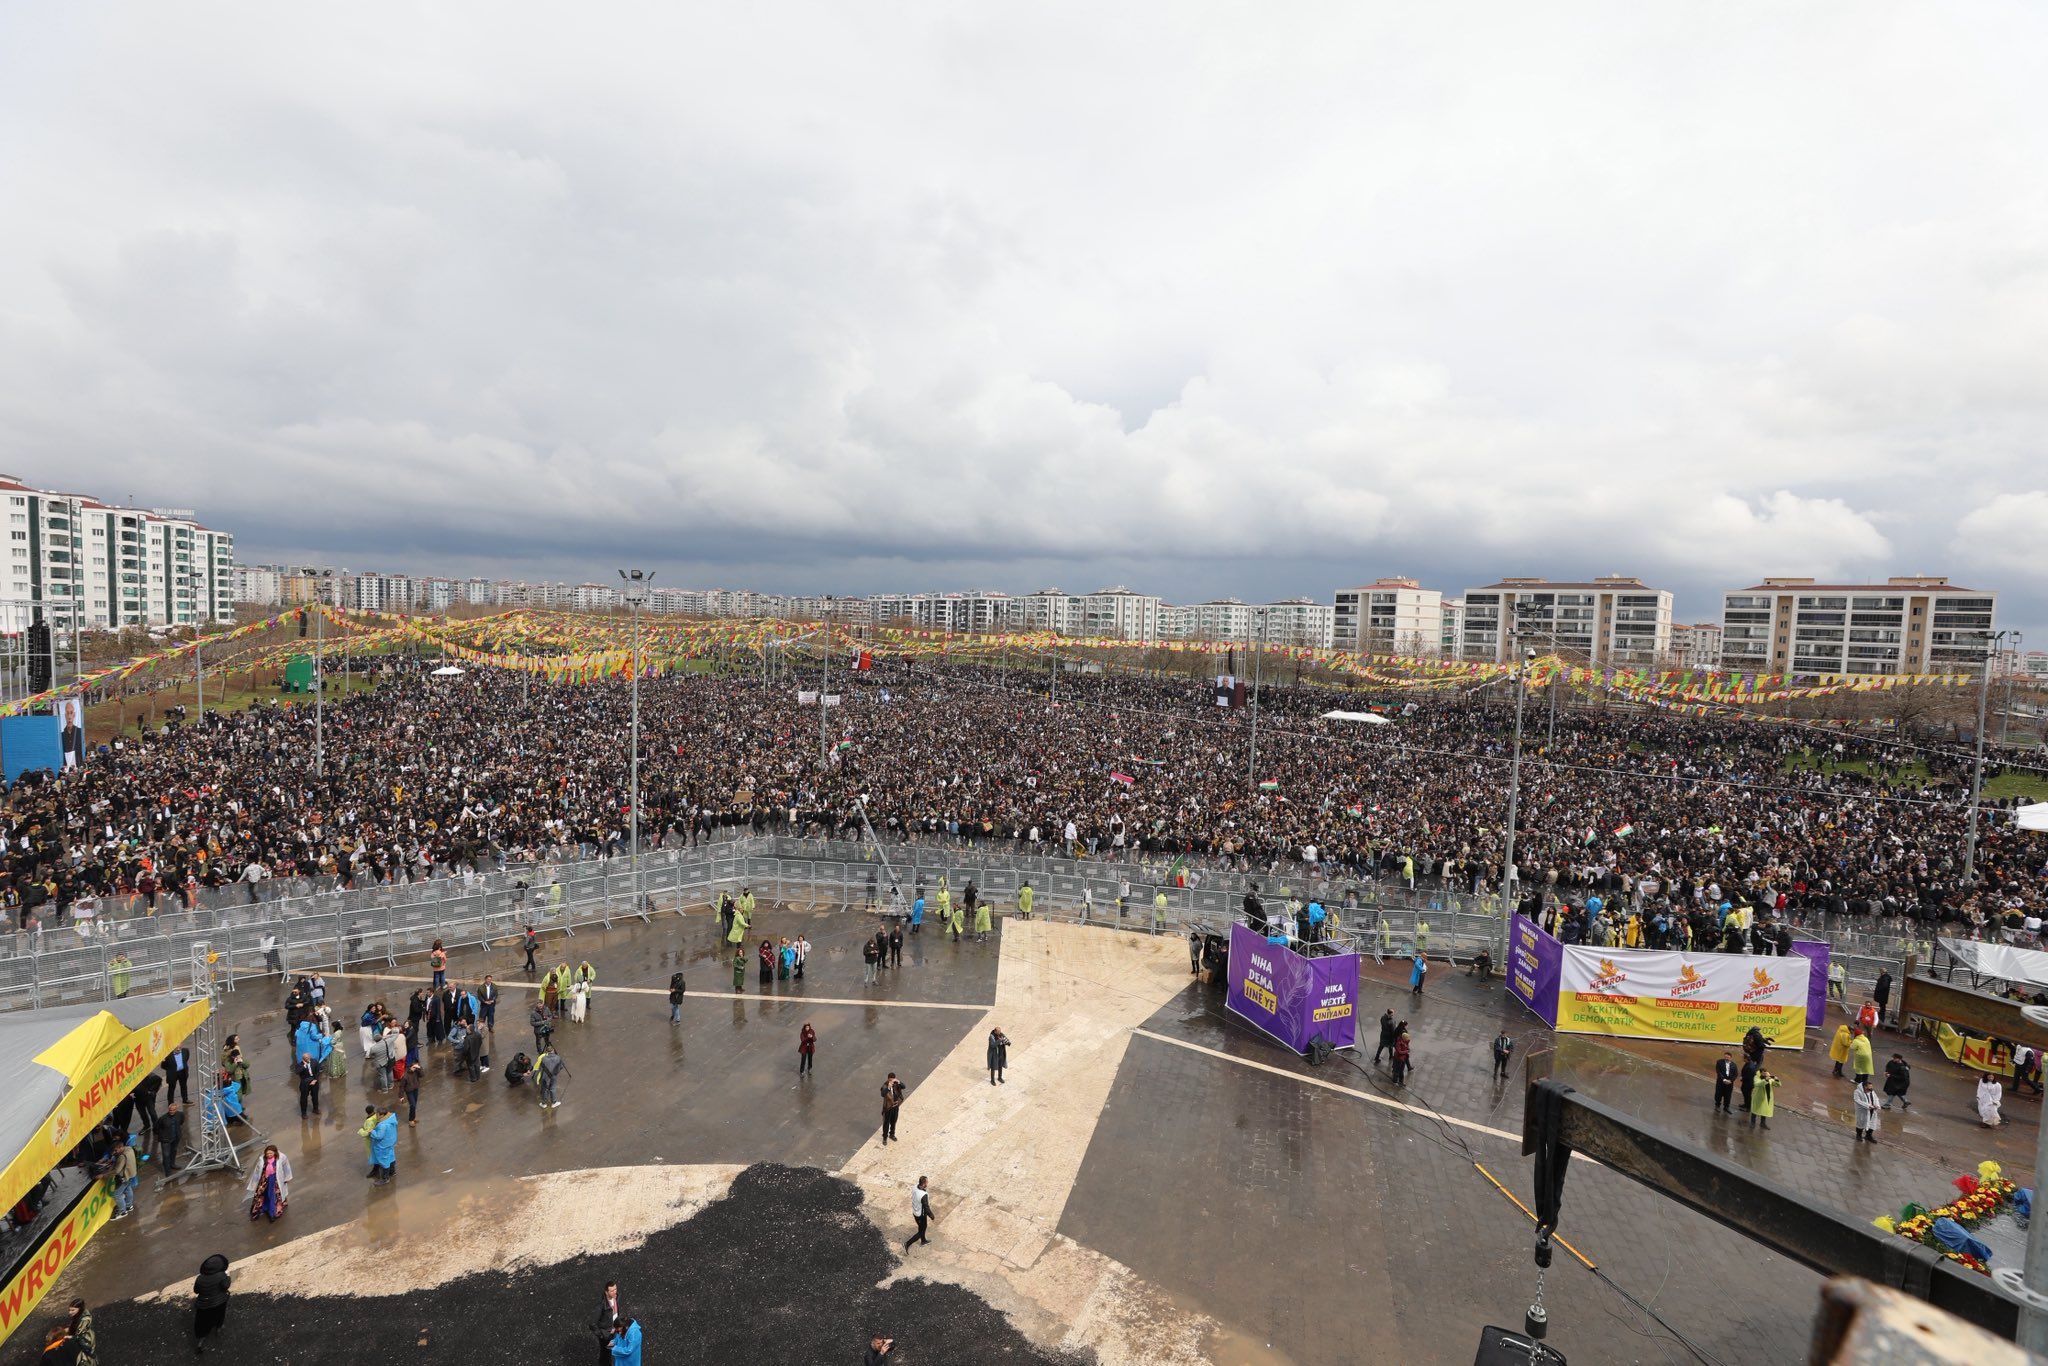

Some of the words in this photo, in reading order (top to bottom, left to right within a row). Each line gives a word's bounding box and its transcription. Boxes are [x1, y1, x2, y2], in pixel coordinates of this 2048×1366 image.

[1251, 953, 1272, 974] NIHA
[1248, 969, 1273, 992] DEMA
[1590, 974, 1626, 990] NEWROZ
[1671, 979, 1707, 996] NEWROZ
[1324, 984, 1343, 994] NIKA
[1743, 983, 1780, 1001] NEWROZ
[1265, 996, 1275, 1012] YE
[1321, 993, 1347, 1007] WEXTÊ
[1657, 1000, 1693, 1009] NEWROZA
[1344, 1007, 1350, 1016] O
[1740, 1004, 1779, 1013] ÖZGÜRLÜK
[1735, 1025, 1780, 1036] NEOZU
[1965, 1043, 2007, 1069] NE
[78, 1043, 144, 1118] NEWROZ
